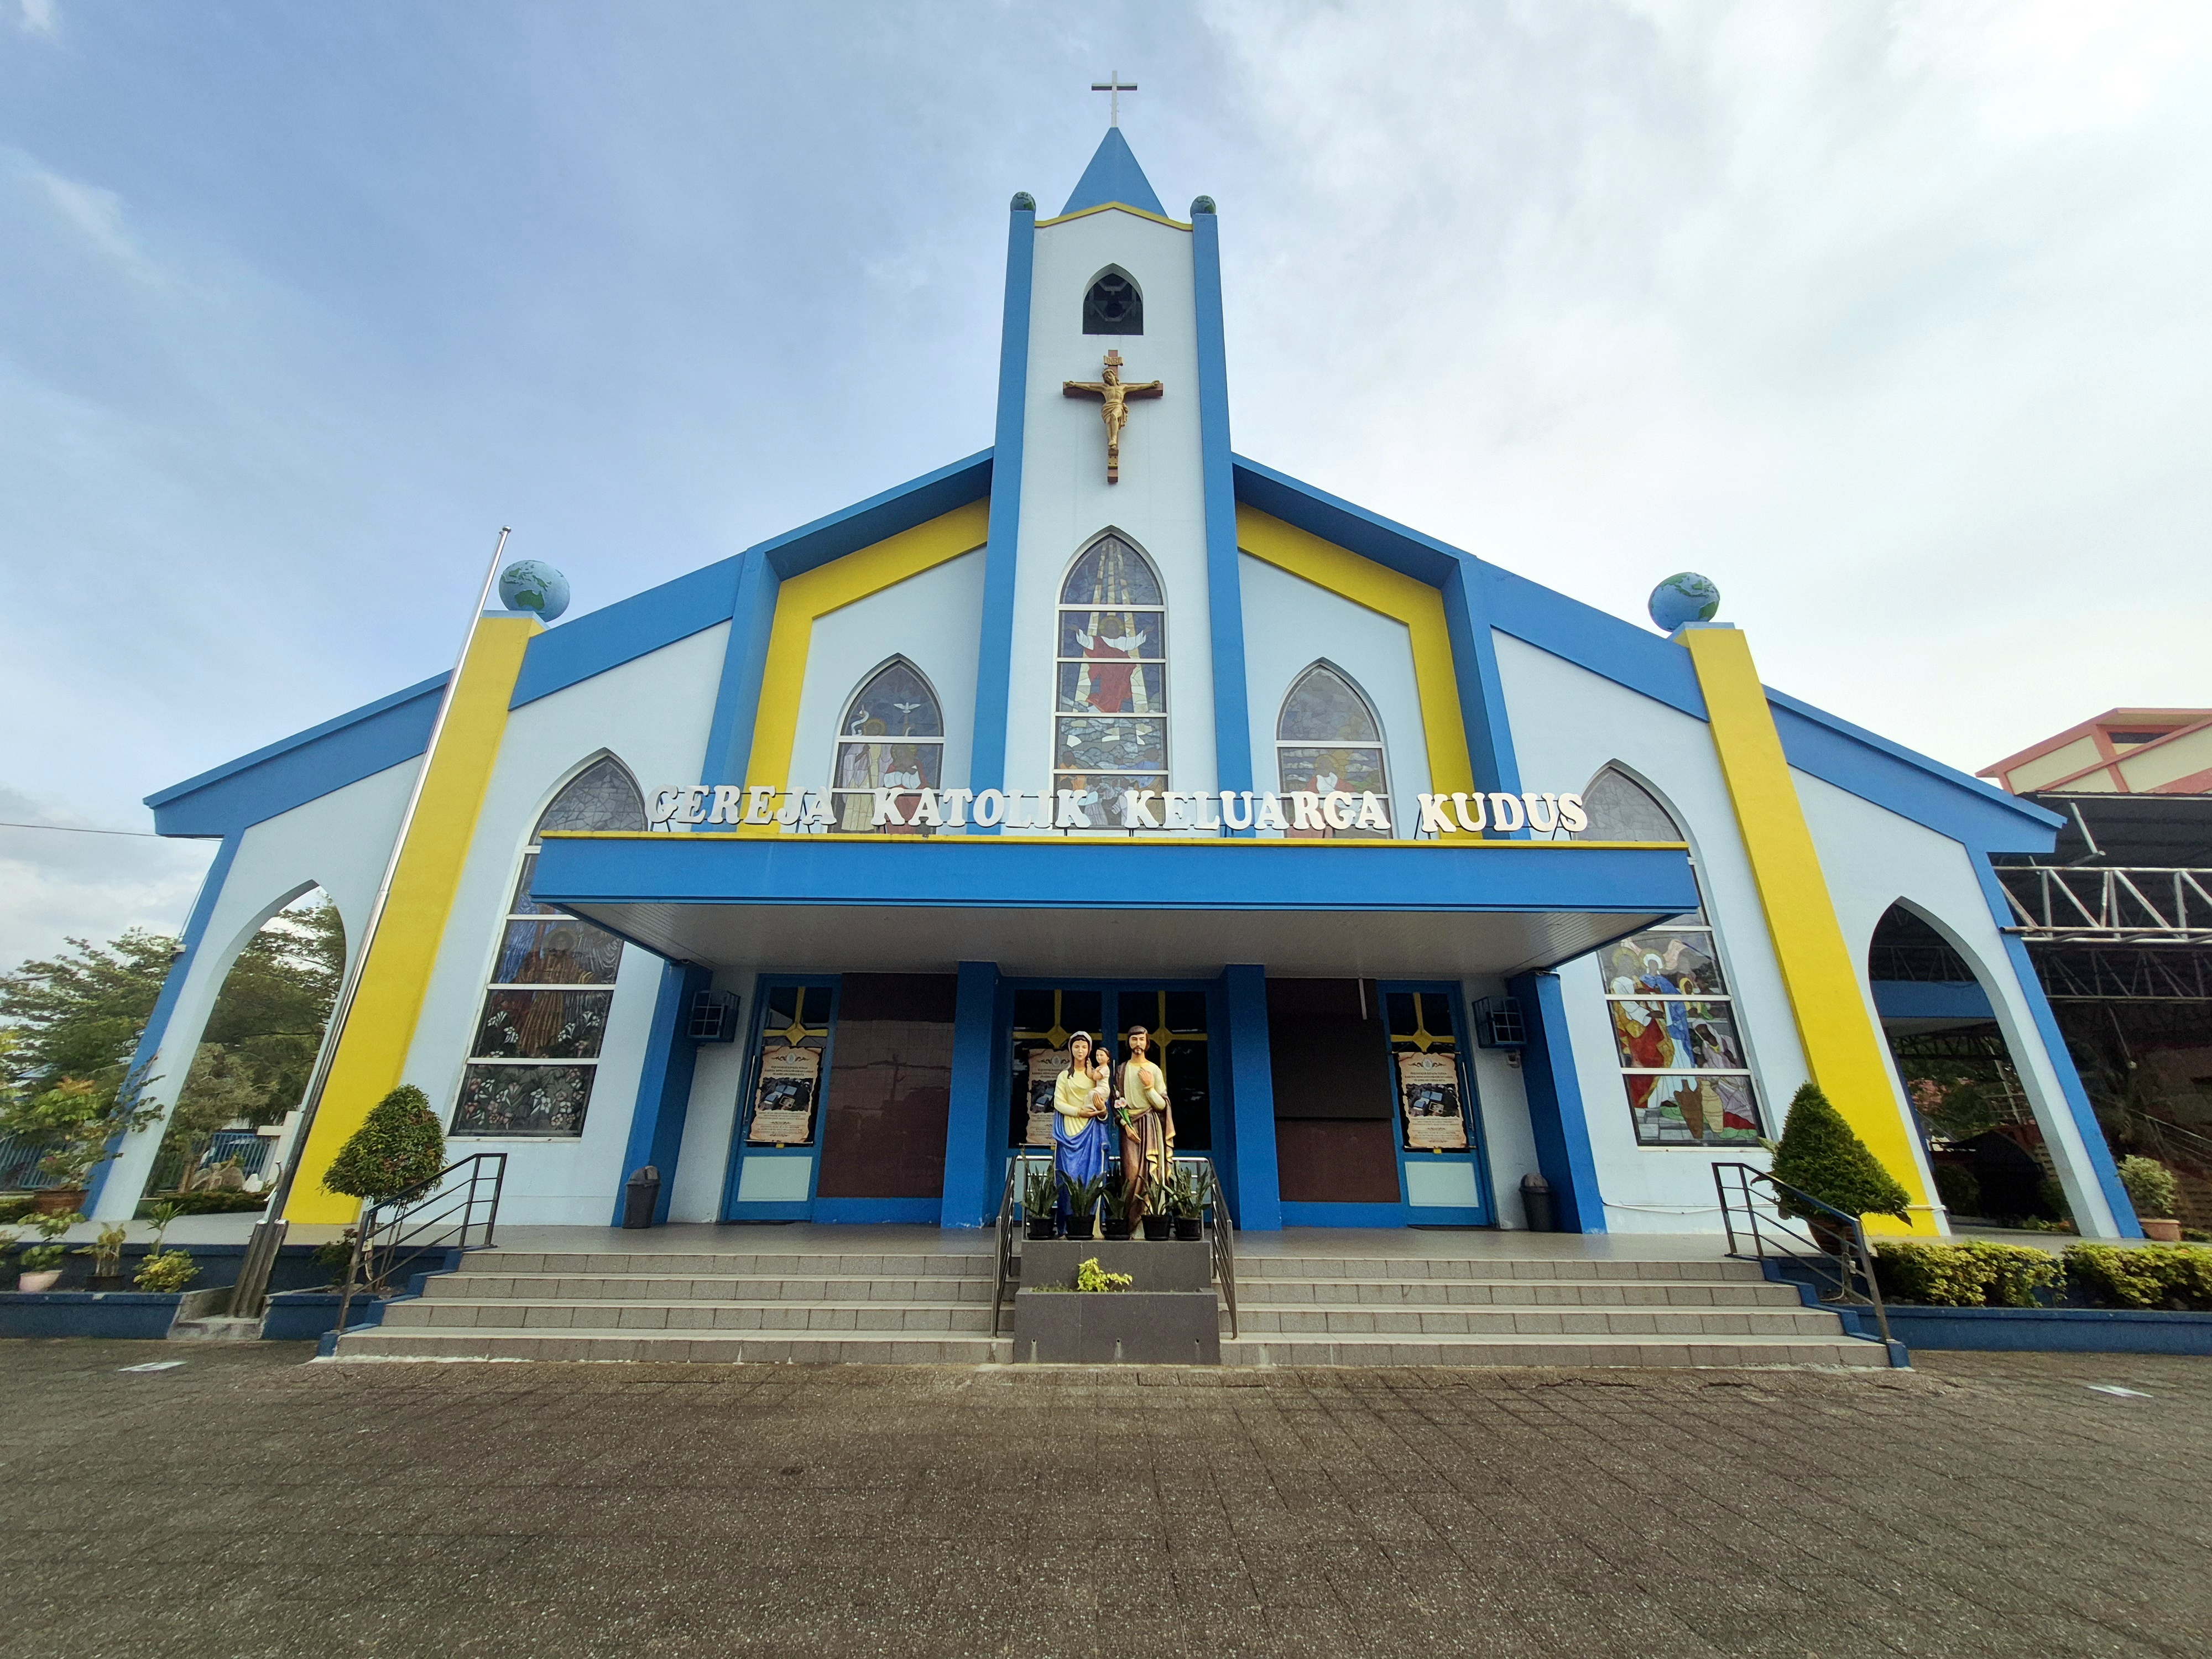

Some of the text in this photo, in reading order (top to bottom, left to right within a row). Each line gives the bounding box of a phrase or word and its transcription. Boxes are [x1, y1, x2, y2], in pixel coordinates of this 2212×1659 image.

[645, 785, 1588, 833] GEREJA KATOLIK KELUARGA KUDUS
